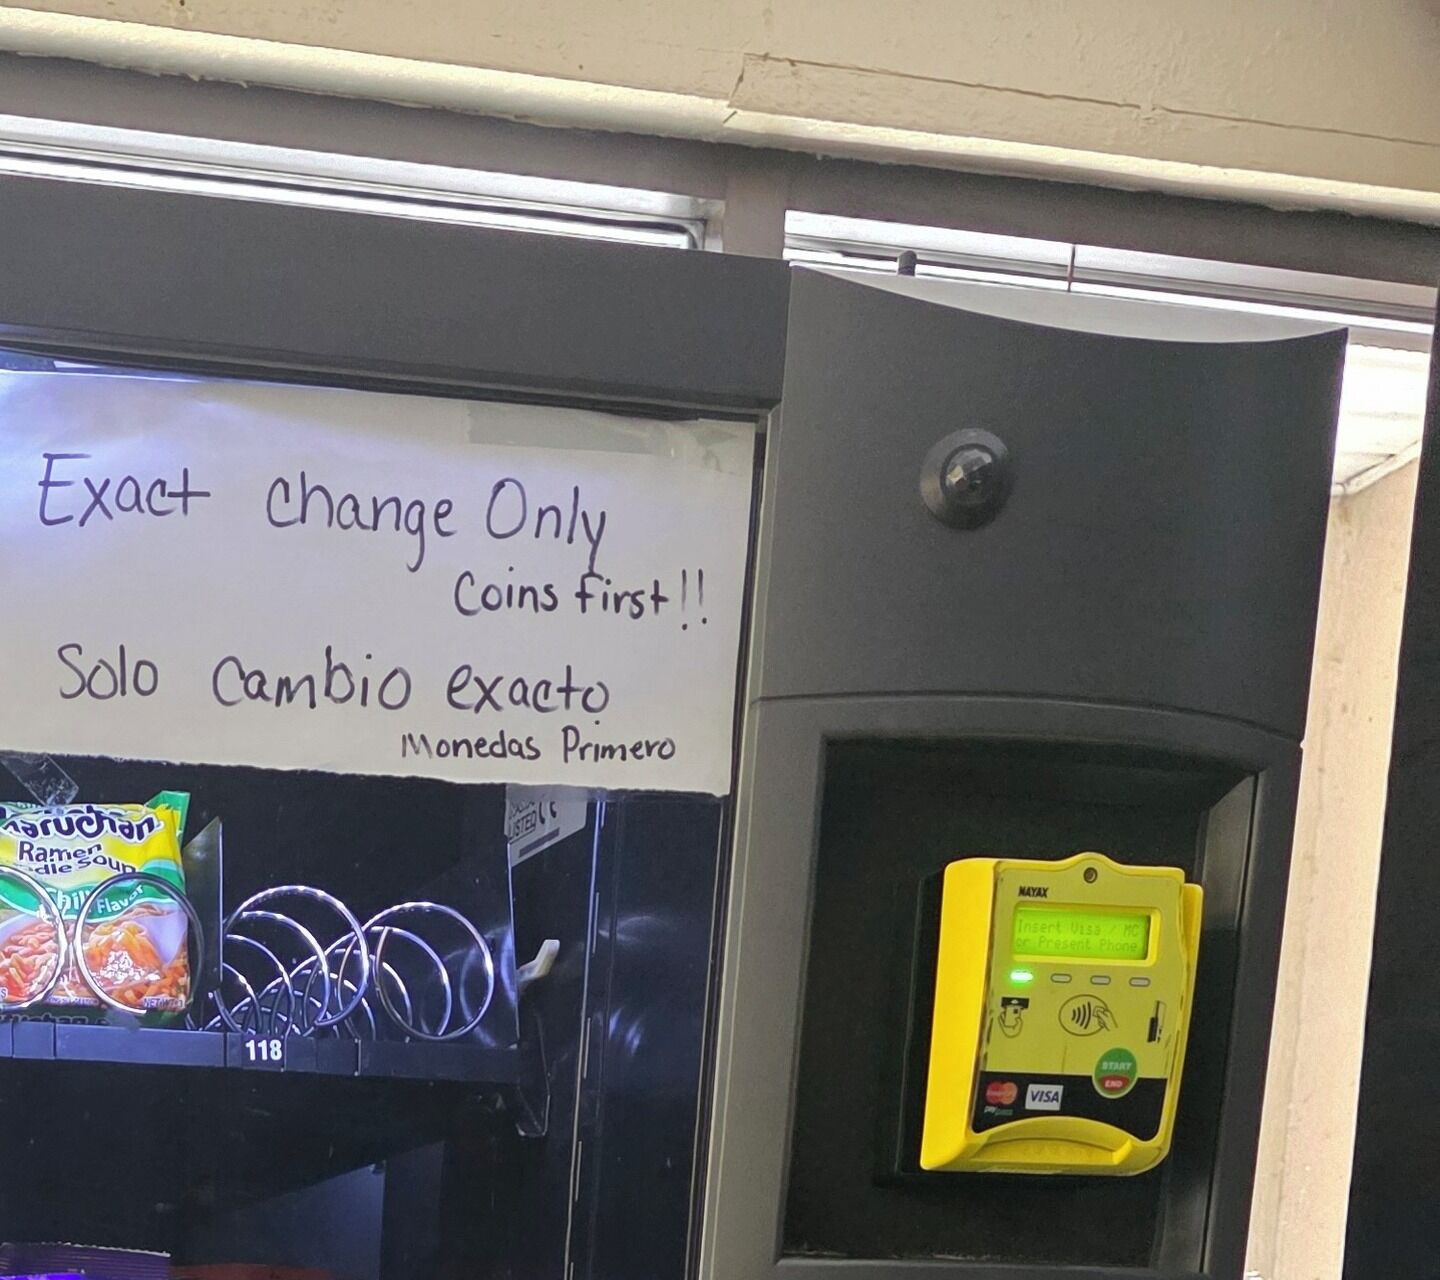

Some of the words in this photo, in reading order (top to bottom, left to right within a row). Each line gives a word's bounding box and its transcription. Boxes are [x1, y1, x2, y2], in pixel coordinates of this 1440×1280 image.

[38, 452, 212, 528] Exact
[485, 477, 607, 576] Only
[453, 566, 559, 617] Coins
[57, 642, 160, 702] Solo
[446, 662, 610, 716] exacto
[401, 731, 542, 762] Monedas
[563, 719, 677, 763] Primero
[18, 840, 104, 863] Ramen
[97, 884, 145, 915] Flavor
[1018, 885, 1049, 898] NAYAX
[1017, 919, 1063, 935] Insert
[1070, 922, 1102, 936] Visa
[1038, 936, 1091, 951] Present
[1099, 938, 1139, 953] Phone
[244, 1038, 283, 1062] 118
[1030, 1090, 1060, 1103] VISA
